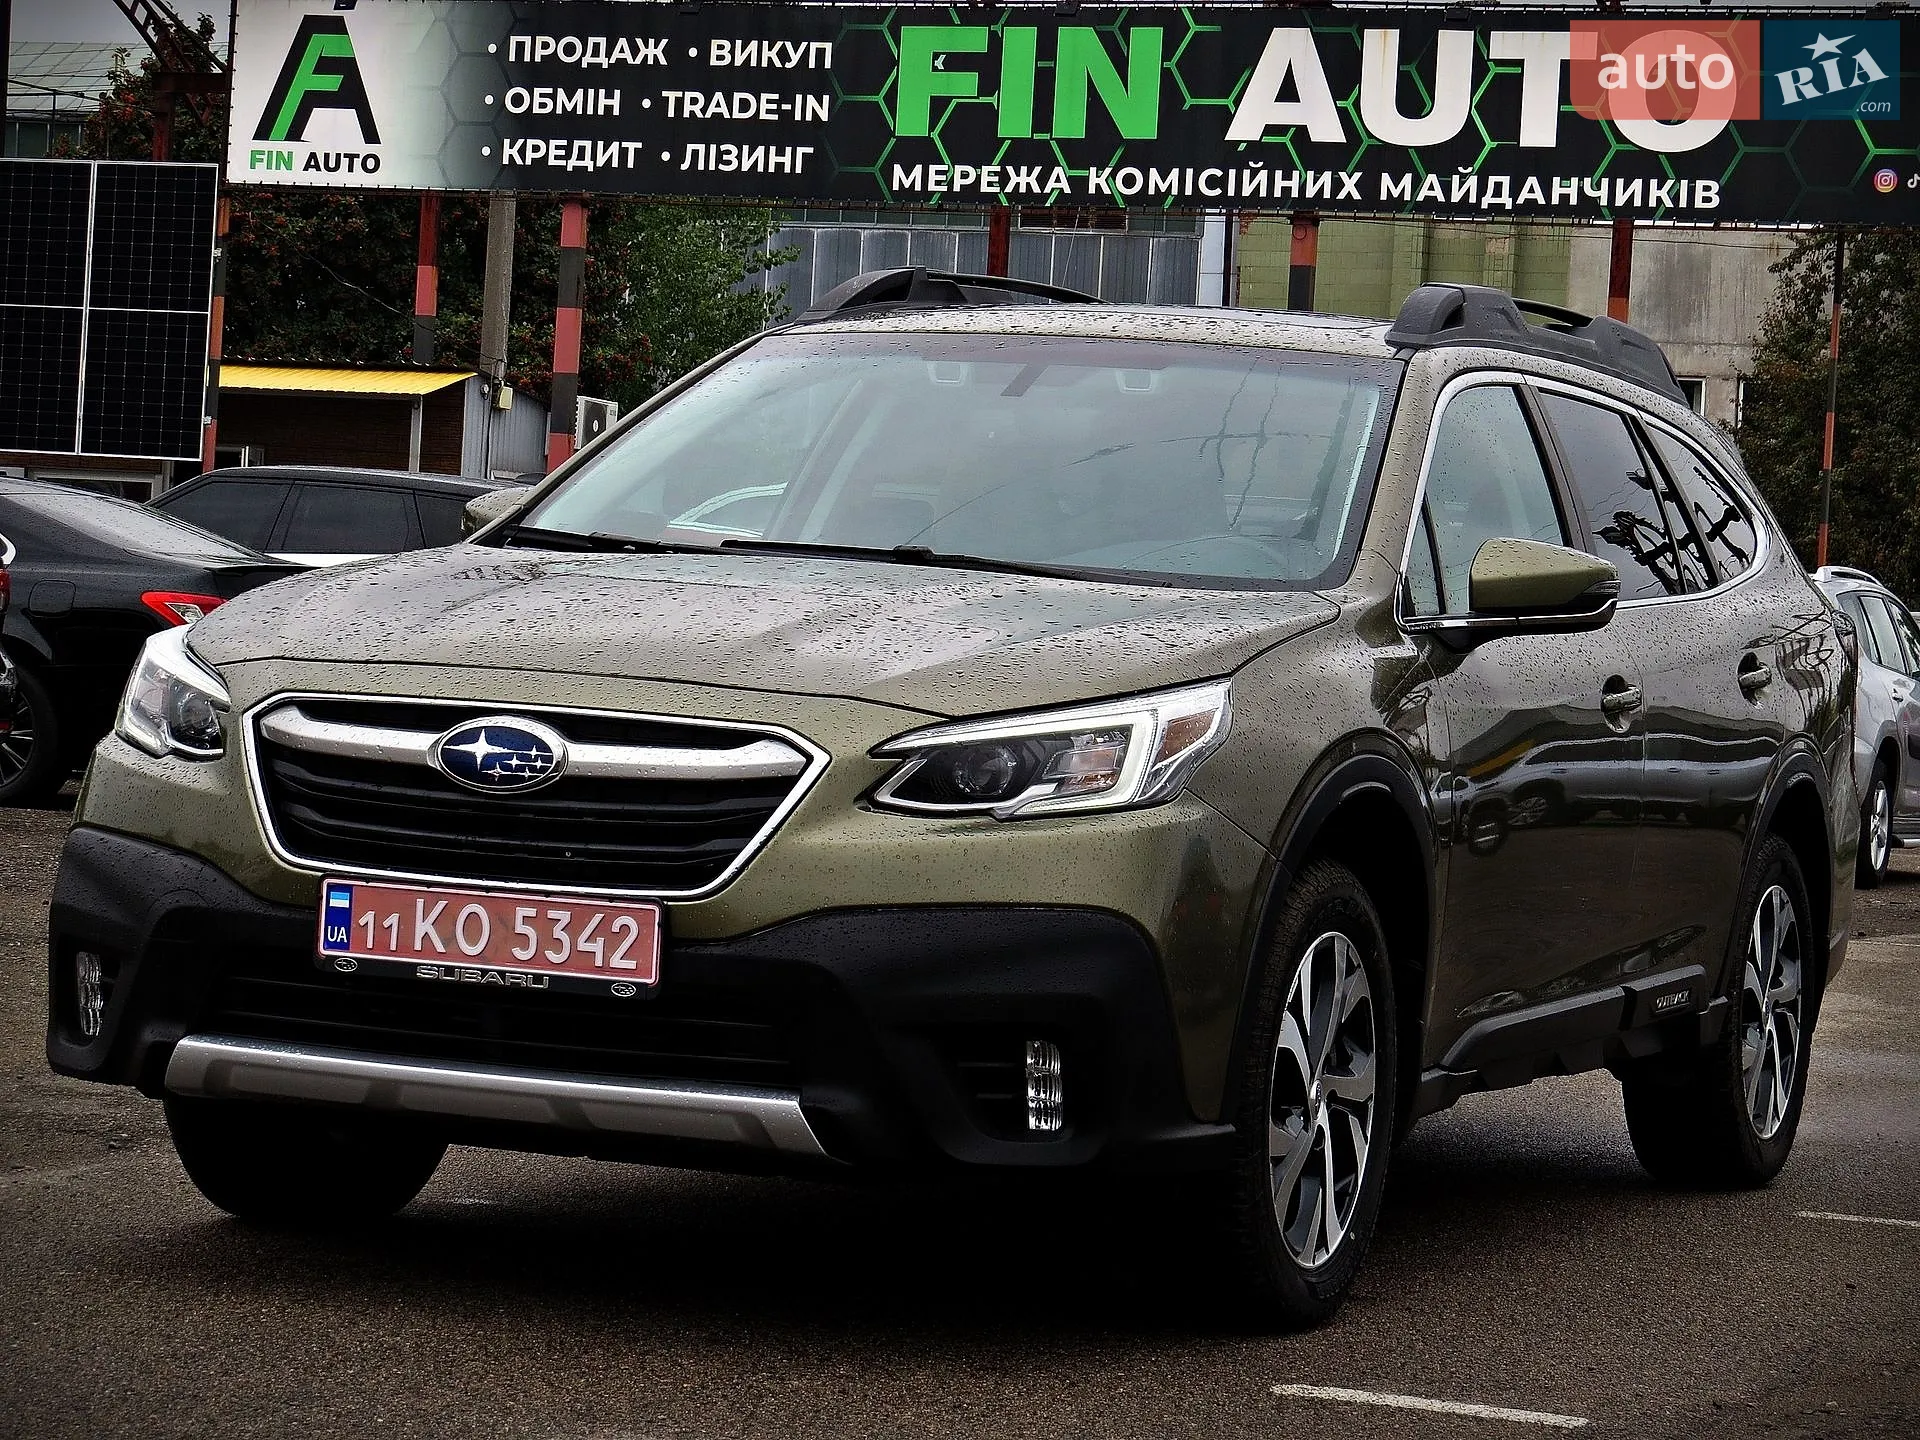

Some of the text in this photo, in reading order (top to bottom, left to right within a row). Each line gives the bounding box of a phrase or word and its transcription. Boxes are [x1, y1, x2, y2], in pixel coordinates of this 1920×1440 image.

[508, 35, 833, 69] ПРОДАЖ ВИКУП
[504, 86, 830, 122] ОБМІН TRADE-IN
[895, 26, 1737, 152] FIN AUTO
[250, 149, 381, 174] FIN AUTO
[502, 138, 814, 174] КРЕДИТ ЛІЗИНГ
[892, 160, 1720, 210] МЕРЕЖА КОМІСІЙНИХ МАЙДАНЧИКІВ
[326, 925, 348, 943] UA
[511, 907, 640, 970] 5342
[416, 965, 550, 990] SUBARU
